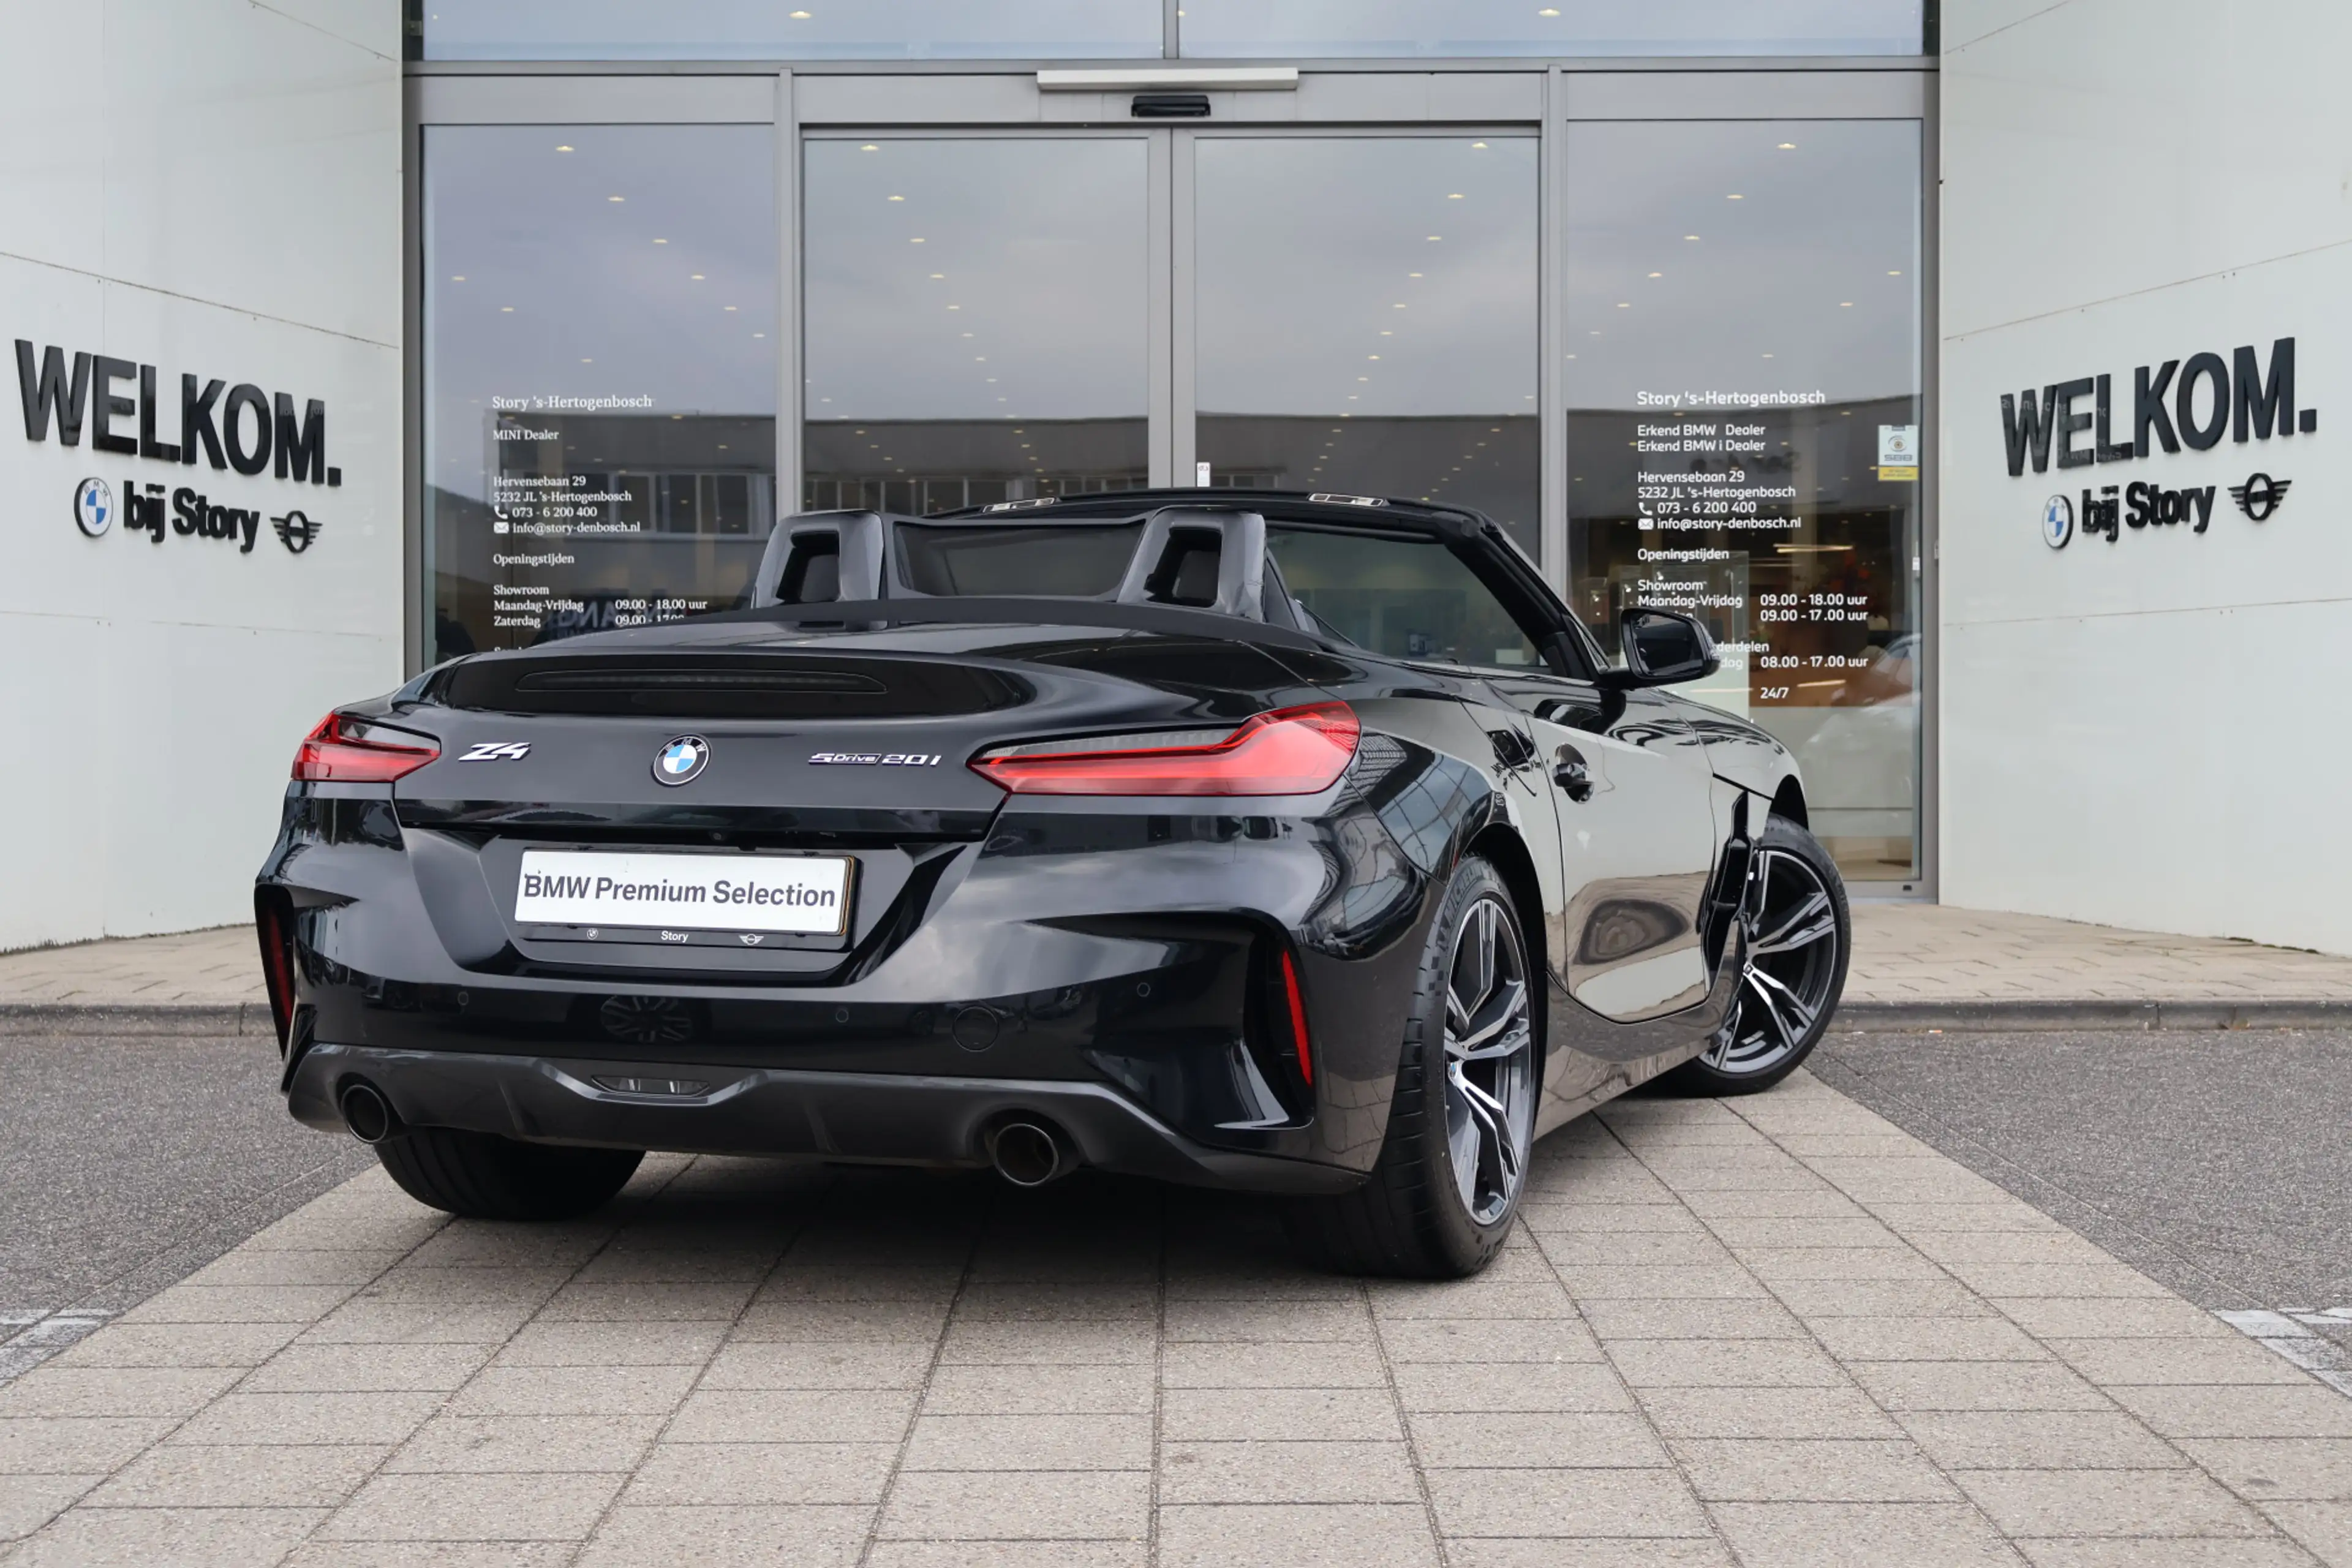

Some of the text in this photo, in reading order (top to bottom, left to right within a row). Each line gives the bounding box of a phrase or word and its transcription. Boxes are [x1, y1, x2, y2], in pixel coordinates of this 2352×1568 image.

[492, 394, 652, 411] Story 's-Hertogenbosch
[1637, 390, 1825, 407] Story 's-Hertogenbosch
[15, 339, 341, 487] WELKOM.
[2000, 337, 2317, 477] WELKOM.
[493, 429, 559, 440] MINI Dealer
[1637, 424, 1765, 436] Erkend BMW Dealer
[1637, 440, 1765, 451] Erkend BMW i Dealer
[494, 476, 586, 488] Hervensebaan 29
[1637, 470, 1744, 482] Hervensebaan 29
[494, 491, 632, 504] 5232 JL 's-Hertogenbosch
[1638, 486, 1796, 500] 5232 JL 's-Hertogenbosch
[512, 507, 533, 518] 073
[543, 507, 551, 517] 6
[553, 507, 574, 517] 200
[576, 507, 598, 517] 400
[1657, 502, 1680, 514] 073
[1692, 502, 1700, 513] 6
[1703, 502, 1728, 513] 200
[1731, 502, 1757, 513] 400
[2081, 481, 2216, 542] bij Story
[124, 480, 260, 554] bij Story
[513, 521, 641, 536] info@story-denbosch.nl
[1657, 517, 1801, 531] info@story-denbosch.nl
[493, 553, 575, 565] Openingstijden
[1638, 548, 1729, 560] Openingstijden
[494, 584, 549, 595] Showroom
[1638, 579, 1703, 591] Showroom
[494, 600, 584, 612] Maandag-Vrijdag
[615, 599, 646, 609] 09.00
[657, 599, 686, 609] 18.00
[688, 601, 707, 609] uur
[1638, 595, 1743, 608] Maandag-Vrijdag
[1760, 594, 1798, 606] 09.00
[1809, 594, 1844, 606] 18.00
[1847, 596, 1868, 605] uur
[494, 615, 541, 628] Zaterdag
[615, 615, 646, 625] 09.00
[1760, 609, 1798, 621] 09.00
[1847, 611, 1868, 621] uur
[1760, 656, 1799, 668] 08.00
[1847, 658, 1869, 668] uur
[1760, 687, 1789, 699] 24/7
[458, 742, 532, 762] Z4
[524, 874, 835, 907] BMW Premium Selection
[660, 930, 689, 943] Story
